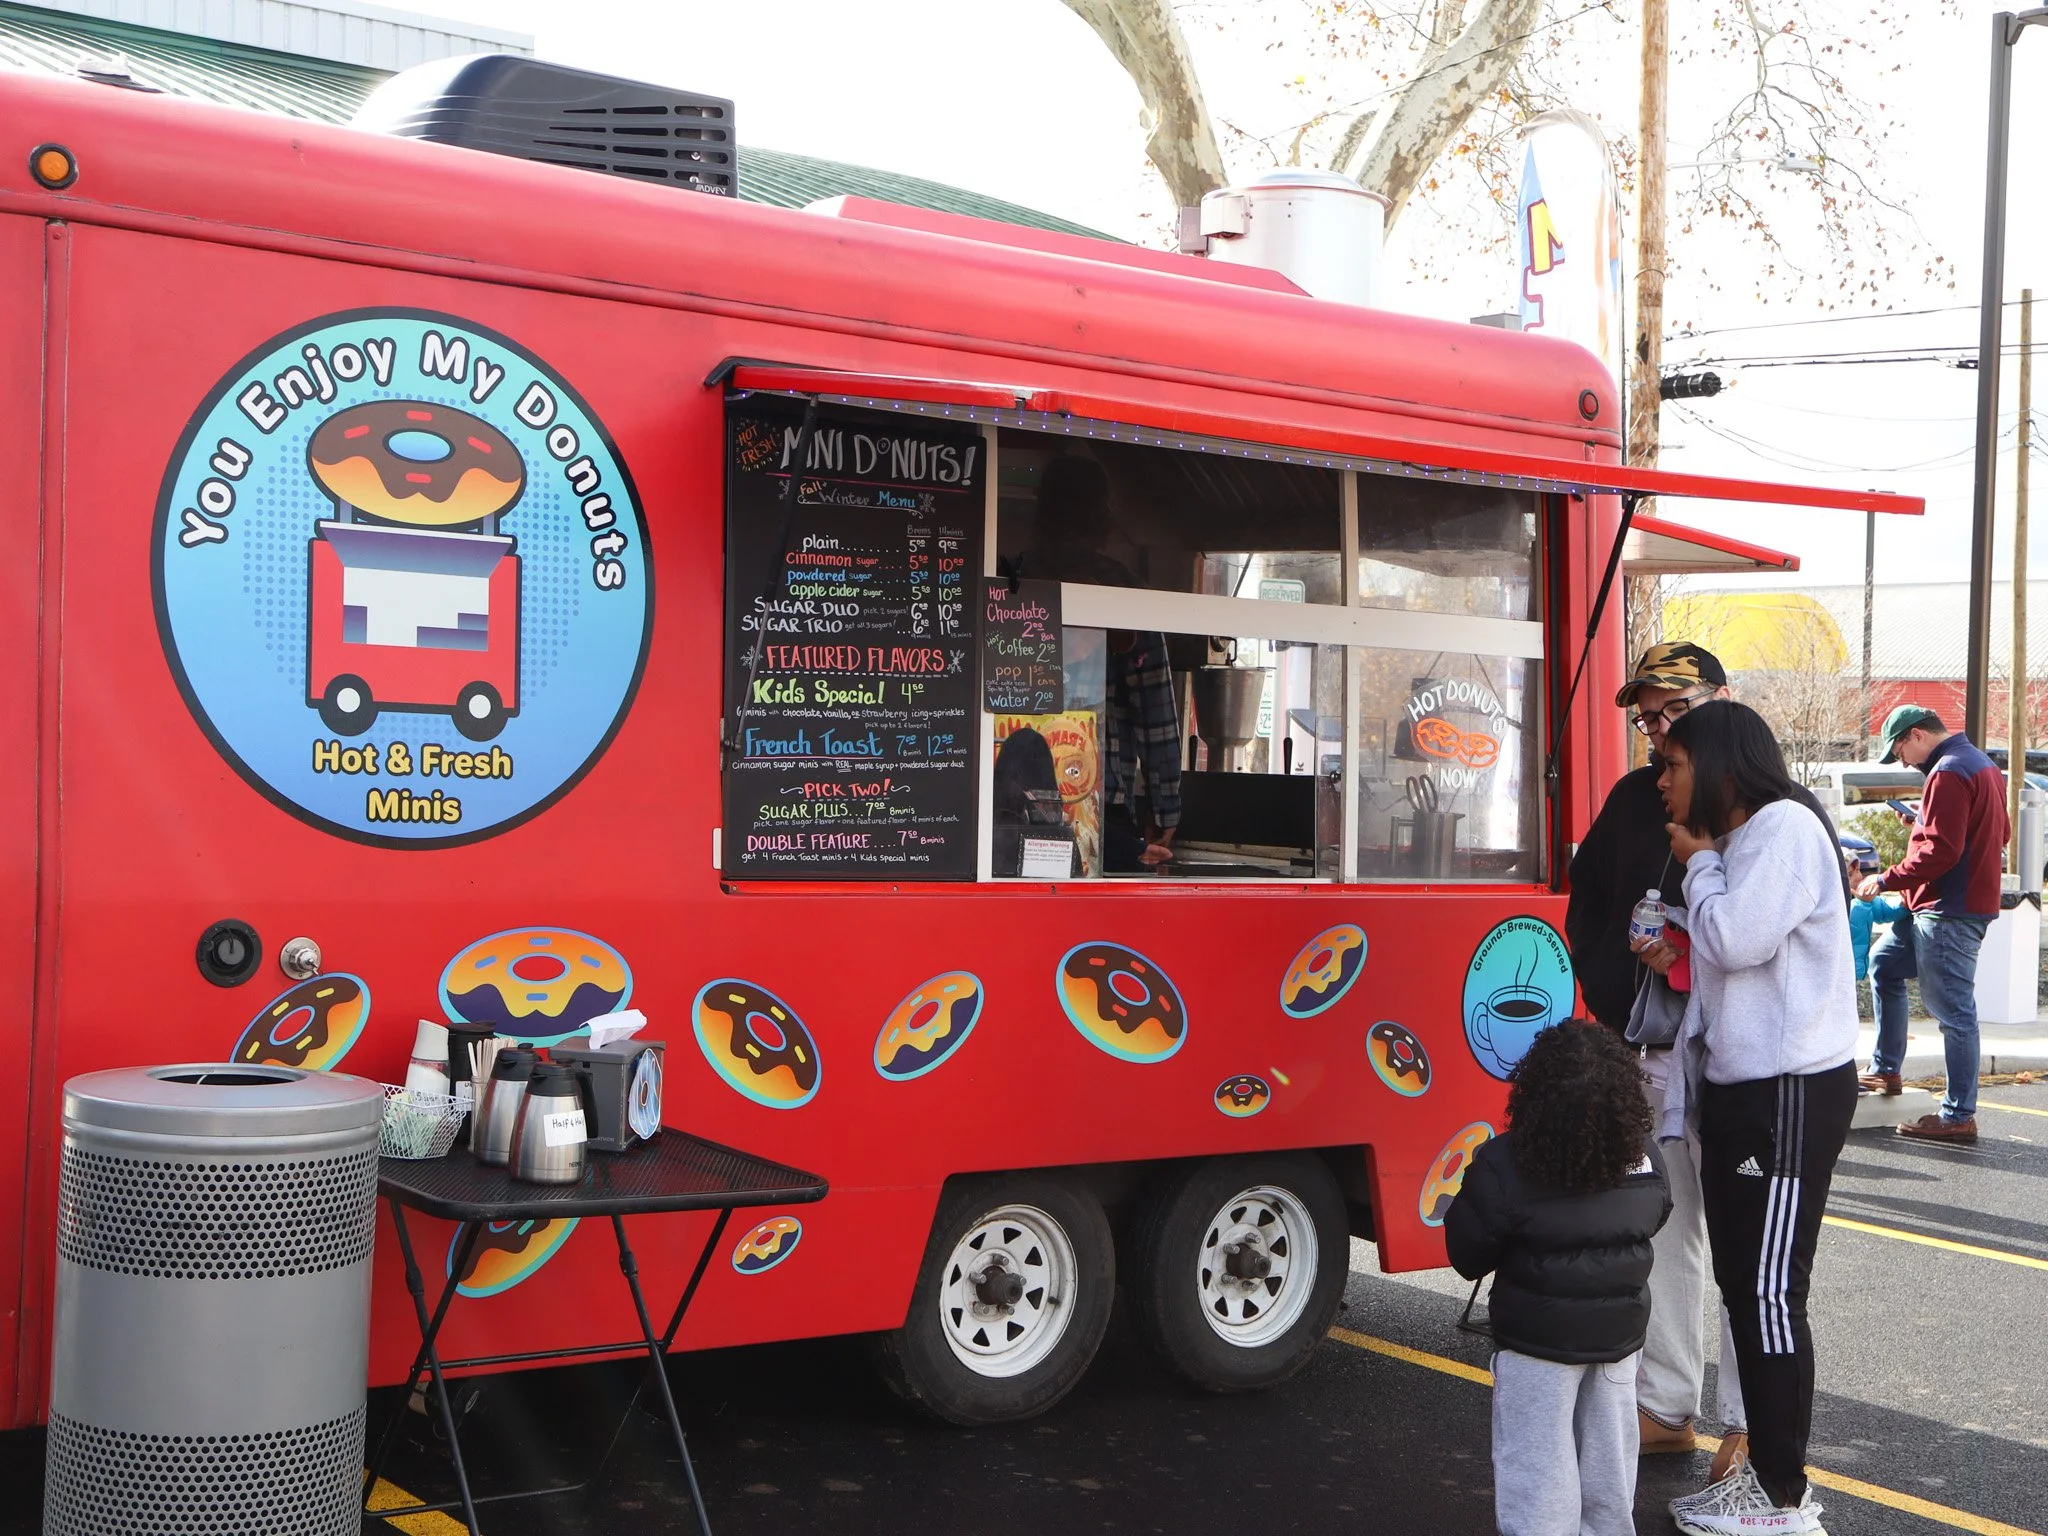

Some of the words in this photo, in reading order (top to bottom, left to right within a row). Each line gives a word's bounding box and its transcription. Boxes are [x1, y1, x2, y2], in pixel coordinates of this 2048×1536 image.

[738, 425, 759, 447] HOT
[182, 438, 252, 546] You
[239, 339, 394, 432] Enjoy
[421, 332, 503, 401] My
[517, 384, 627, 590] Donuts
[800, 480, 822, 495] Fall
[819, 490, 869, 505] Winter
[877, 491, 916, 508] Menu
[785, 568, 846, 586] powdered
[789, 583, 827, 600] apple
[829, 583, 860, 598] cider
[989, 585, 1009, 601] HOT
[1262, 588, 1301, 602] RESERVED
[754, 596, 820, 615] SUGAR
[821, 602, 860, 617] DUO
[863, 607, 879, 616] pick
[986, 600, 1050, 624] Chocolate
[741, 614, 803, 633] SUGAR
[803, 618, 843, 633] TRIO
[844, 621, 855, 632] get
[998, 638, 1035, 657] Coffee
[766, 645, 861, 671] FEATURED
[867, 647, 945, 673] FLAVORS
[995, 666, 1022, 681] pop
[753, 678, 806, 705] Kids
[745, 707, 767, 717] minis
[861, 708, 908, 721] strawberry
[1407, 685, 1444, 722] HOT
[1446, 679, 1508, 734] DONUTS
[865, 722, 879, 730] pick
[745, 728, 813, 757] French
[819, 728, 884, 756] Toast
[315, 742, 376, 776] Hot
[388, 744, 411, 774] &
[422, 745, 512, 780] Fresh
[732, 761, 772, 772] cinnamon
[773, 761, 796, 773] sugar
[798, 760, 819, 770] minis
[835, 760, 853, 770] REAL
[854, 762, 874, 773] maple
[900, 760, 929, 771] powdered
[930, 762, 949, 772] sugar
[950, 760, 965, 769] dust
[1440, 767, 1477, 788] NOW
[804, 783, 846, 799] PICK
[849, 778, 891, 797] TWO!
[366, 790, 461, 824] Minis
[759, 804, 811, 820] SUGAR
[753, 820, 773, 830] pick
[791, 820, 813, 831] sugar
[857, 817, 887, 825] featured
[747, 834, 806, 851] DOUBLE
[741, 853, 757, 863] get
[762, 852, 769, 861] 4
[772, 852, 796, 861] French
[797, 853, 820, 861] Toast
[822, 852, 842, 861] minis
[850, 853, 857, 862] 4
[860, 852, 878, 862] Kids
[909, 853, 930, 862] minis
[552, 1119, 569, 1129] Half
[1736, 1167, 1764, 1177] adidas
